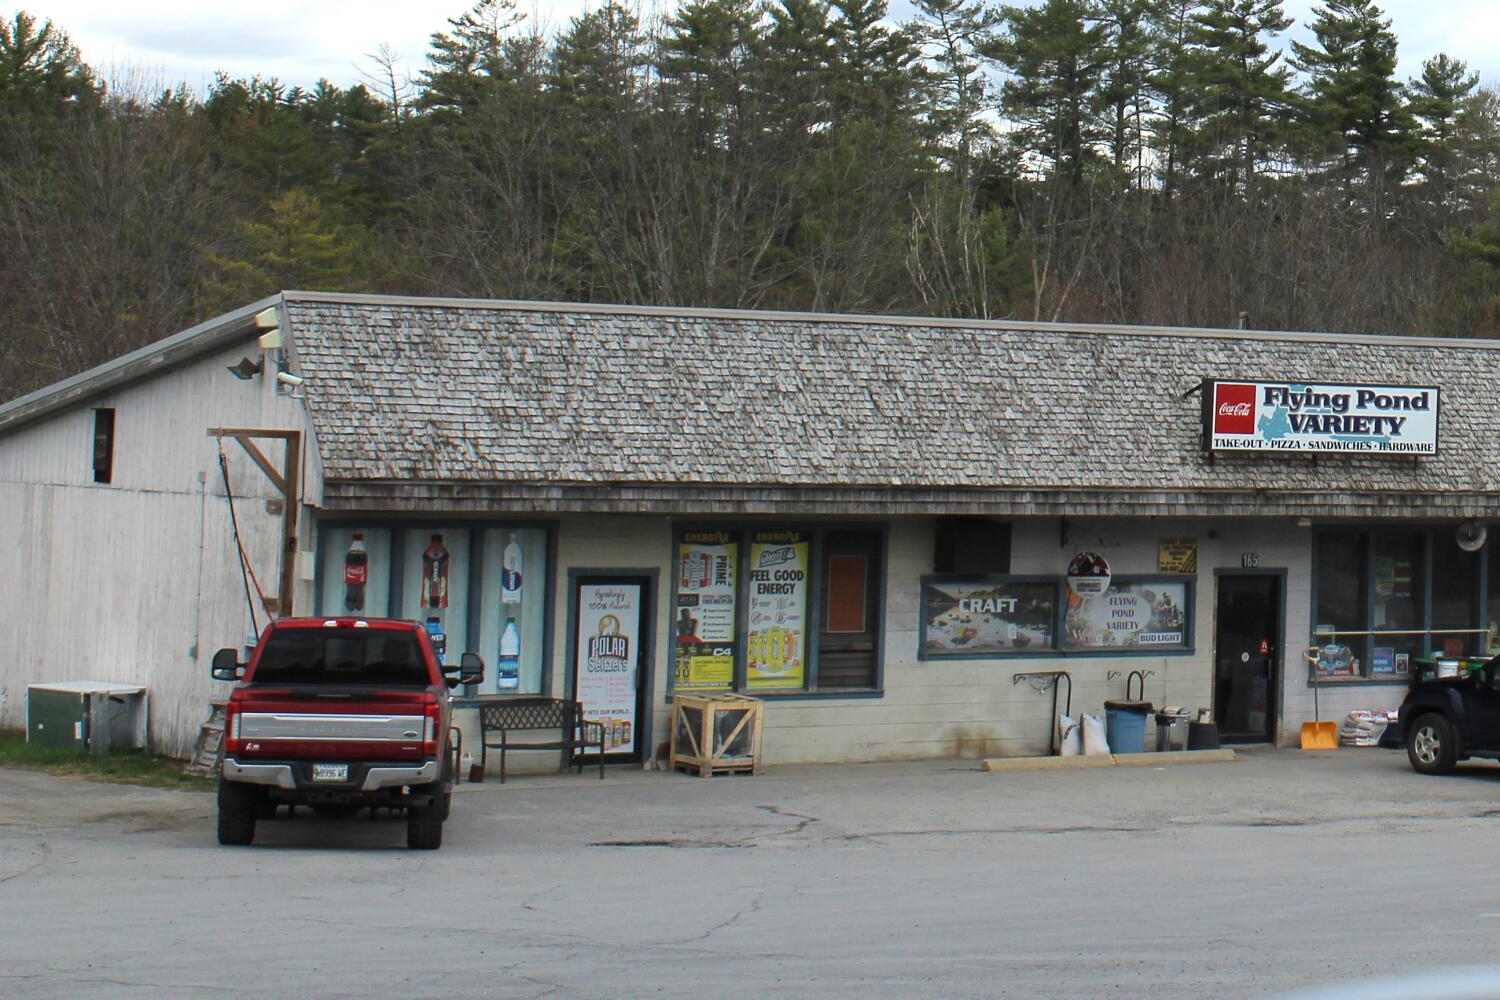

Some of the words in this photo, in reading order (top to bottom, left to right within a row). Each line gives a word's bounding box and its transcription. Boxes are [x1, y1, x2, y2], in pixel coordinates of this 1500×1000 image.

[1263, 386, 1351, 413] Flying
[1355, 389, 1430, 411] Pond
[1288, 413, 1407, 436] VARIETY
[1214, 438, 1263, 449] TAKE-OUT
[1270, 440, 1301, 450] PIZZA
[1308, 441, 1372, 451] SANDWICHES
[1379, 442, 1434, 453] HARDWARE
[1242, 553, 1258, 567] 165
[716, 555, 727, 586] PRIME
[750, 569, 771, 582] FEEL
[774, 569, 804, 582] GOOD
[757, 582, 796, 595] ENERGY
[958, 598, 1018, 613] CRAFT
[1109, 596, 1138, 607] FLYING
[1112, 609, 1135, 619] POND
[1106, 620, 1140, 631] VARIETY
[1140, 634, 1156, 643] BUD
[1157, 634, 1181, 643] LIGHT
[591, 636, 627, 657] POLAR
